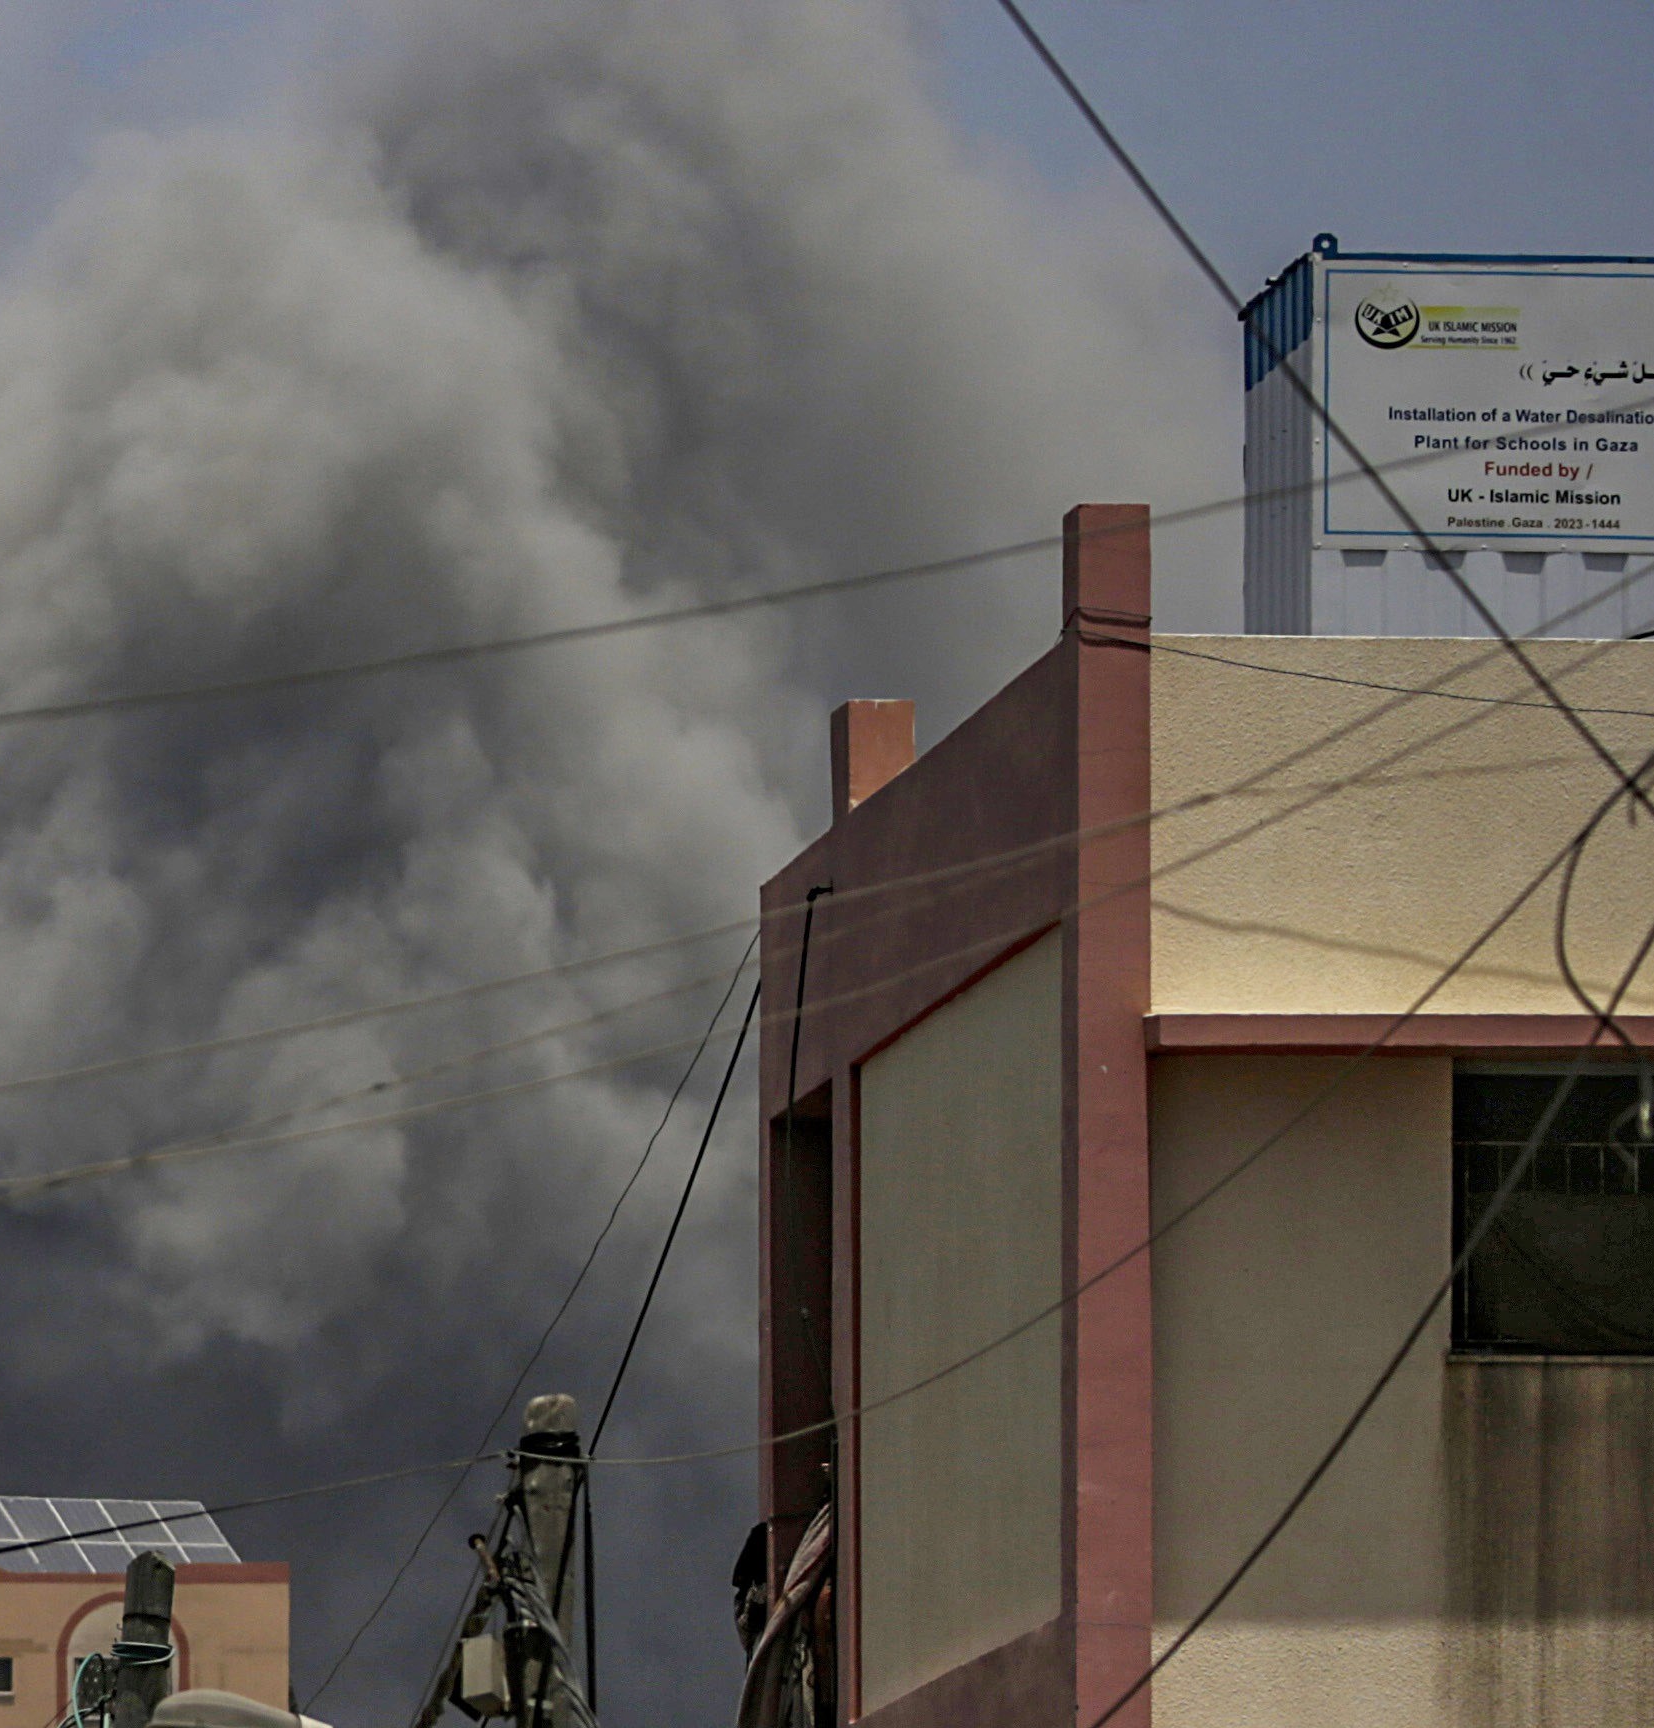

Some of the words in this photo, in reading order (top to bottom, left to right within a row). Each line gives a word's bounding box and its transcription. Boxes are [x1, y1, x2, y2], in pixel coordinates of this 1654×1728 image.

[1362, 303, 1384, 325] UK
[1428, 321, 1441, 332] UK
[1443, 321, 1479, 333] ISLAMIC
[1481, 321, 1518, 333] MISSION
[1421, 336, 1446, 345] Serving
[1448, 336, 1479, 345] Humanity
[1481, 336, 1499, 345] Since
[1388, 406, 1477, 422] Installation
[1481, 408, 1498, 422] of
[1501, 411, 1511, 422] a
[1515, 408, 1561, 423] Water
[1565, 409, 1654, 425] Desalinatio
[1414, 435, 1459, 450] Plant
[1464, 436, 1489, 450] for
[1495, 436, 1567, 451] Schools
[1573, 437, 1589, 451] in
[1595, 438, 1639, 452] Gaza
[1484, 461, 1553, 477] Funded
[1558, 463, 1580, 481] by
[1447, 488, 1473, 503] UK
[1490, 489, 1550, 504] Islamic
[1555, 490, 1621, 505] Mission
[1447, 516, 1505, 528] Palestine
